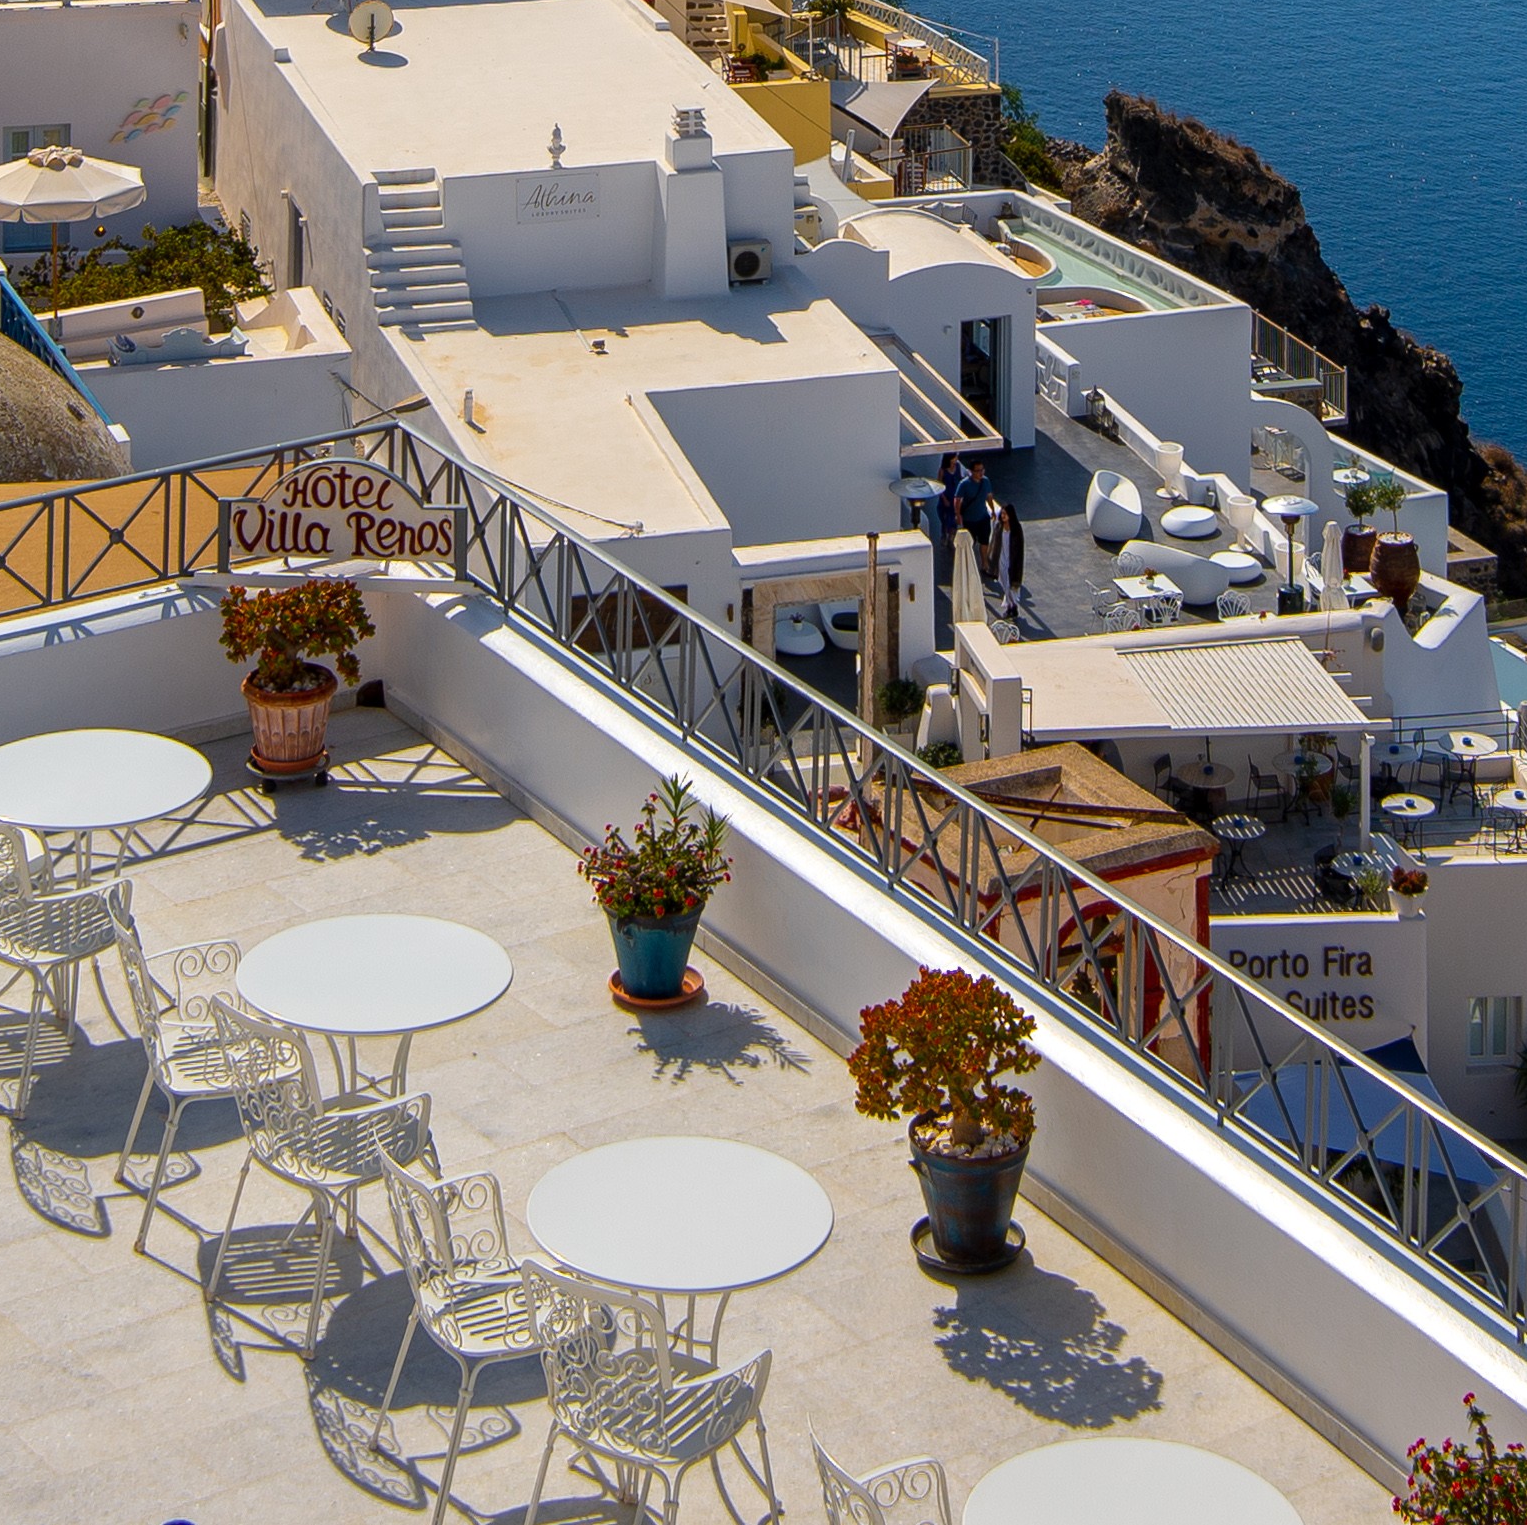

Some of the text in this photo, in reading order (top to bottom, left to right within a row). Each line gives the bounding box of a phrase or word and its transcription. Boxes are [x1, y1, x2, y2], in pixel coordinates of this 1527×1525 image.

[521, 182, 596, 213] Athina
[281, 465, 394, 511] Hotel
[233, 504, 453, 558] Villa Renos
[1229, 945, 1374, 980] Porto Fira
[1286, 990, 1375, 1022] Suites
